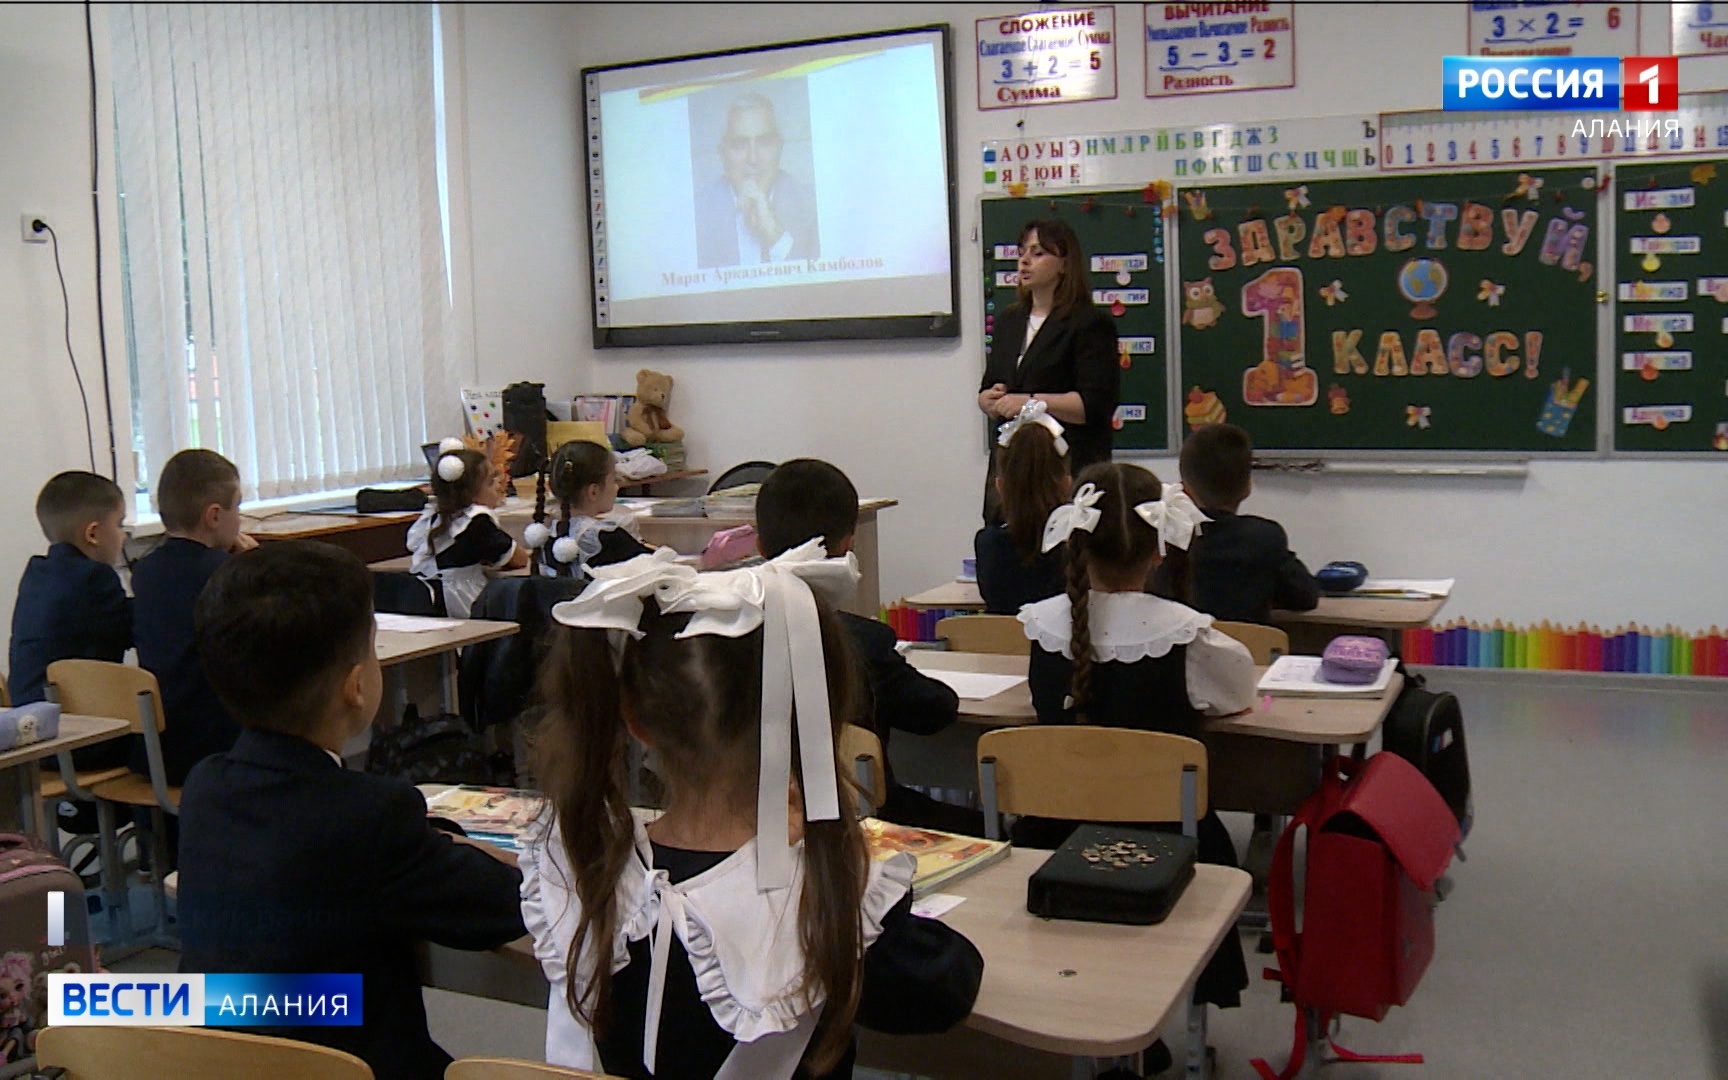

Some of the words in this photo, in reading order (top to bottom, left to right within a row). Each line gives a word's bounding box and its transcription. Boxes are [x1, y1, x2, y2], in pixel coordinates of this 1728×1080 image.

[999, 11, 1096, 35] СЛОЖЕНИЕ
[1493, 15, 1505, 37] 3
[1545, 12, 1560, 34] 2
[1606, 7, 1621, 29] 6
[1001, 59, 1013, 79] 3
[1048, 56, 1059, 74] 2
[1090, 51, 1101, 70] 5
[1167, 45, 1179, 66] 5
[1218, 41, 1230, 62] 3
[1263, 37, 1276, 59] 2
[997, 85, 1061, 104] Сумма
[1203, 202, 1593, 282] ЗДРАВСТВУЙ,
[661, 271, 706, 288] Марат
[806, 256, 884, 274] Камболов
[1241, 267, 1319, 406] 1
[1331, 328, 1544, 379] КЛАСС!
